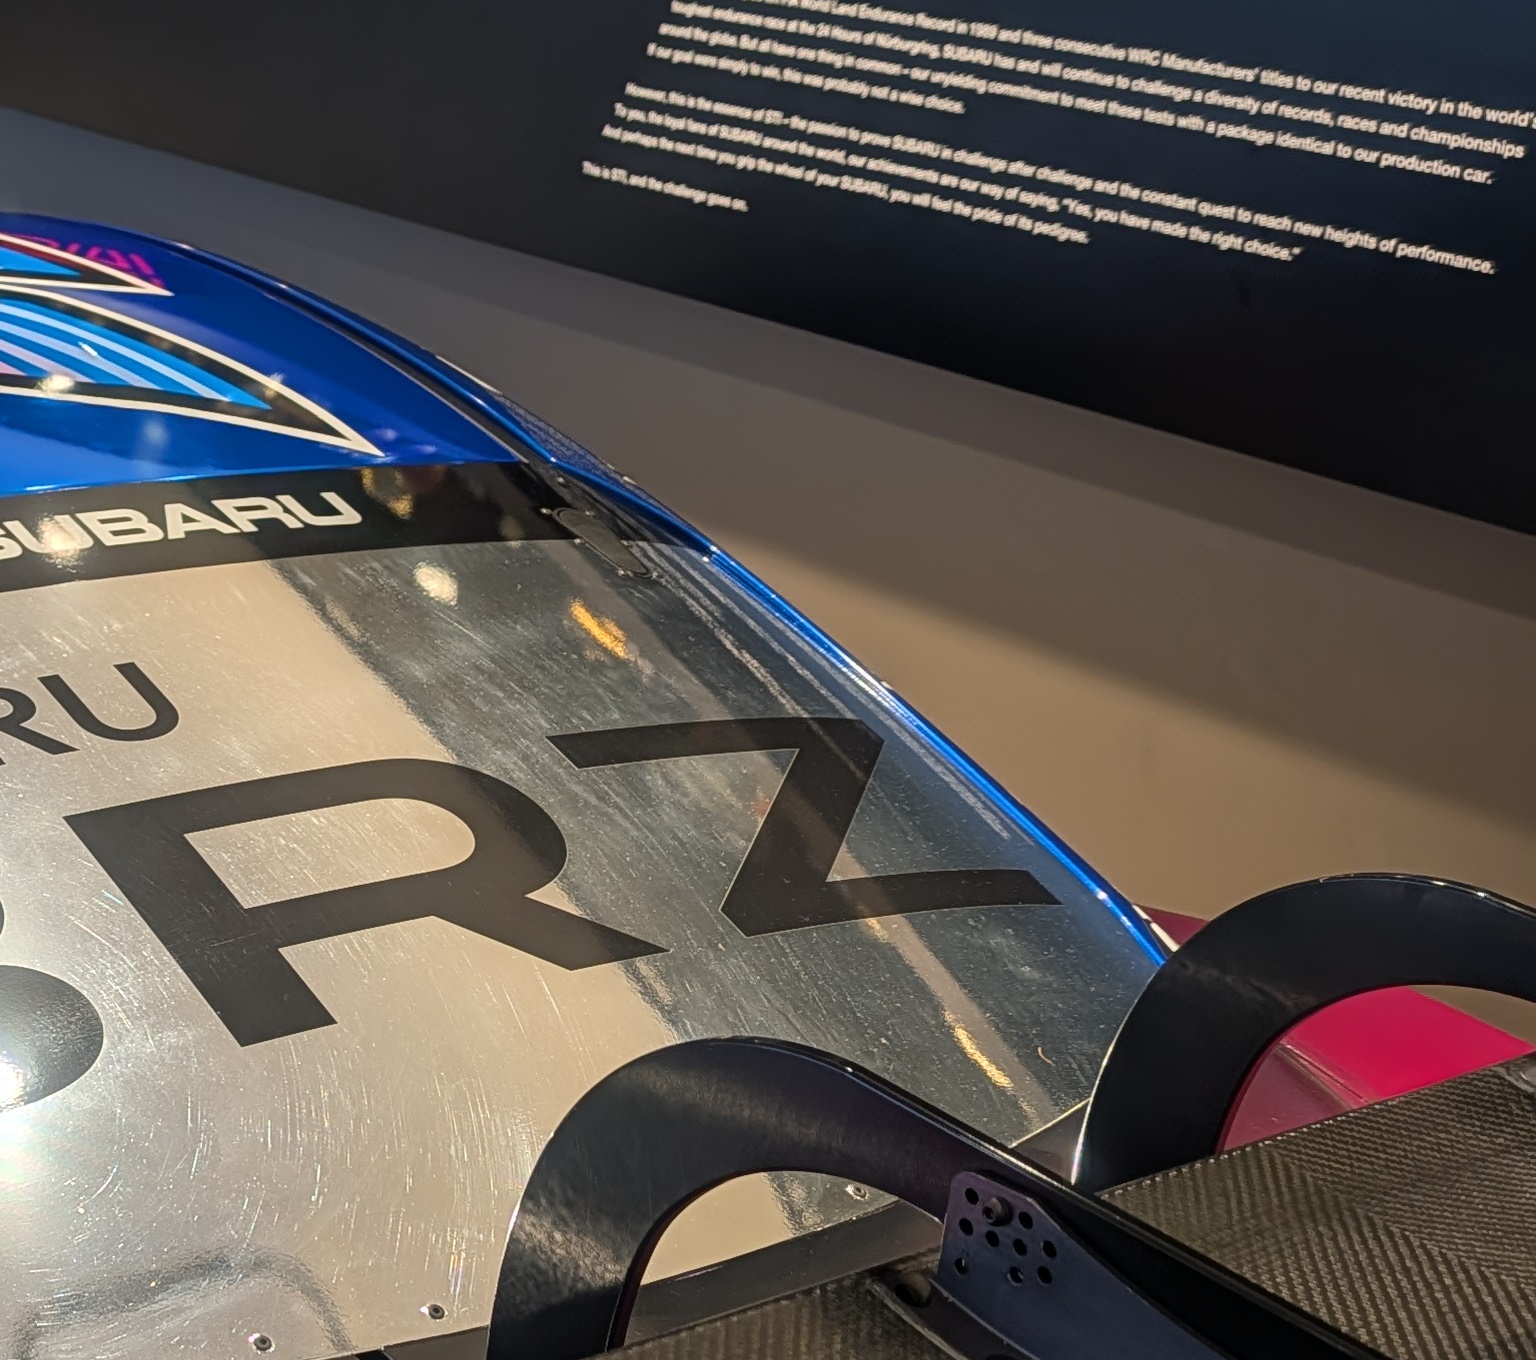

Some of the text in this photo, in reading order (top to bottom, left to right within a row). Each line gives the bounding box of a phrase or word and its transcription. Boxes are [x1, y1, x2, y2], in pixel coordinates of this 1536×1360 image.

[1259, 68, 1297, 89] titles
[1294, 74, 1313, 92] to
[1311, 80, 1340, 96] our
[1337, 84, 1387, 104] recent
[1387, 90, 1439, 116] victory
[1438, 97, 1456, 116] in
[1456, 101, 1484, 120] the
[1175, 114, 1206, 132] with
[1215, 122, 1277, 147] package
[1274, 130, 1338, 156] identical
[1335, 142, 1355, 159] to
[1352, 147, 1382, 164] our
[1378, 152, 1462, 179] production
[1462, 167, 1495, 185] car.
[1203, 89, 1262, 116] diversity
[1260, 99, 1280, 116] of
[1336, 114, 1379, 133] races
[1378, 121, 1411, 139] and
[1409, 125, 1526, 160] championships
[1187, 225, 1214, 244] the
[1210, 230, 1245, 251] right
[1196, 201, 1239, 221] quest
[1235, 206, 1254, 224] to
[1251, 212, 1295, 232] reach
[1292, 221, 1327, 238] new
[1323, 224, 1380, 250] heights
[1377, 237, 1399, 254] of
